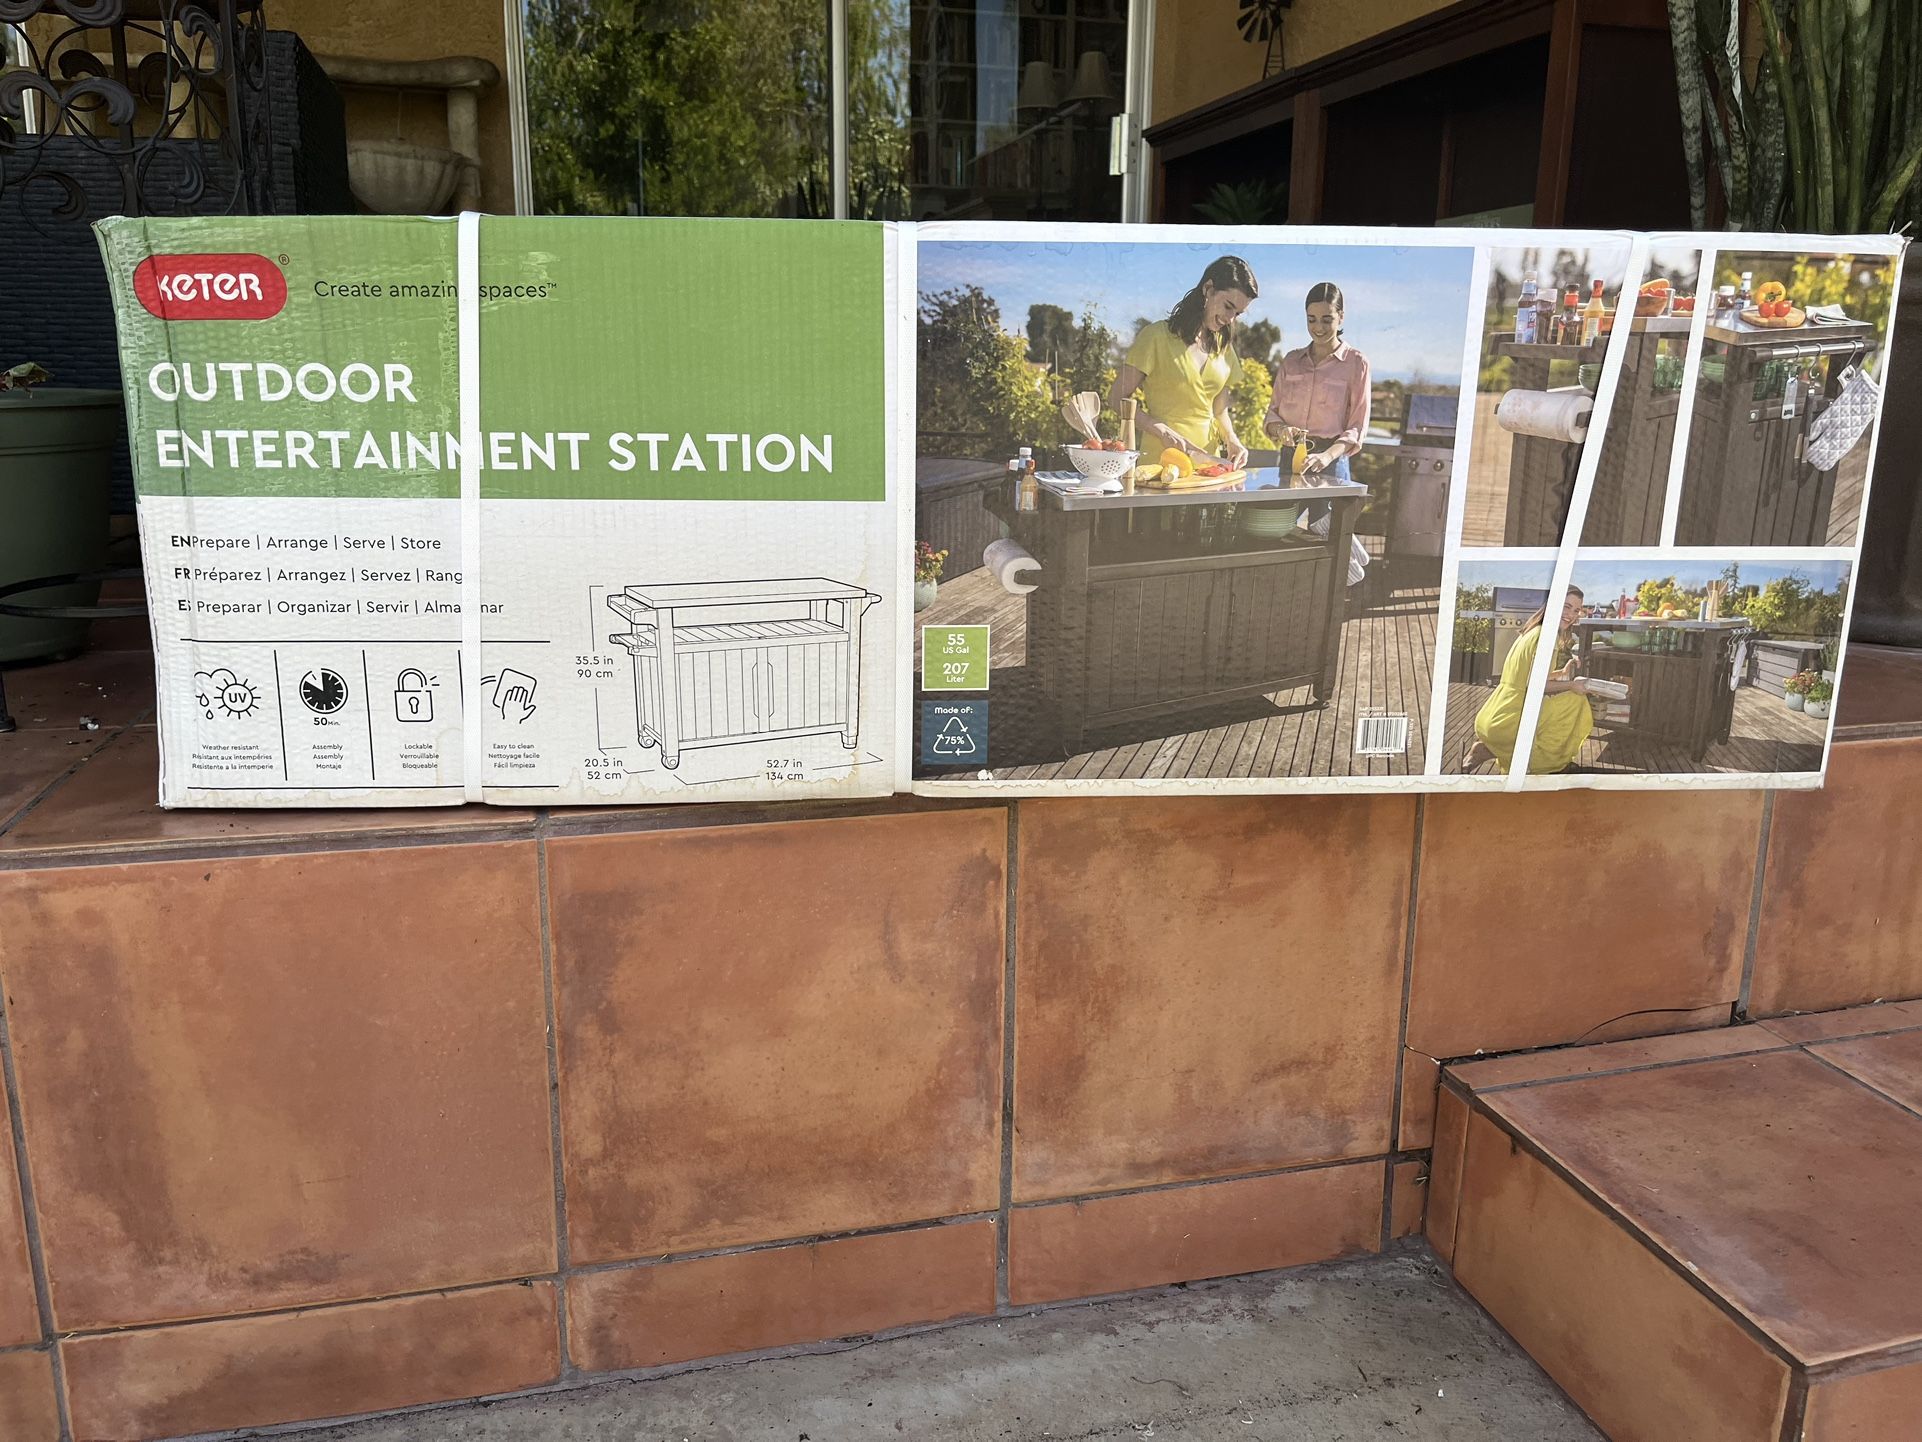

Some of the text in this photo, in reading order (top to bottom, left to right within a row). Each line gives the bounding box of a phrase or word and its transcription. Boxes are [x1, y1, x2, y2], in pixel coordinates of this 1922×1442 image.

[314, 280, 382, 298] Create
[390, 279, 458, 298] amazin
[148, 362, 418, 403] OUTDOOR
[608, 432, 833, 473] STATION
[192, 535, 251, 551] Prepare
[267, 536, 328, 552] Arrange
[343, 536, 386, 549] Serve
[400, 536, 441, 550] Store
[174, 567, 191, 580] FR
[194, 566, 262, 584] Préparez
[277, 568, 346, 584] Arrangez
[360, 569, 411, 582] Servez
[196, 600, 262, 616] Preparar
[277, 599, 352, 616] Organizar
[366, 600, 410, 614] Servir
[947, 633, 965, 646] 55
[942, 646, 970, 654] US Gal
[575, 655, 614, 666] 35.5 in
[577, 668, 613, 679] 90 cm
[942, 662, 970, 675] 207
[946, 675, 965, 683] Liter
[228, 692, 247, 704] UV
[944, 735, 965, 745] 75%
[311, 743, 344, 752] Assembly
[492, 743, 508, 751] Easy
[312, 753, 345, 761] Assembly
[399, 752, 440, 760] Verrouillable
[488, 752, 541, 761] Nettoyage facile
[230, 763, 238, 771] la
[238, 763, 274, 772] intemperie
[315, 763, 342, 771] Montaje
[402, 762, 439, 770] Bloqueable
[509, 761, 536, 770] limpieza
[584, 757, 624, 768] 20.5 in
[766, 758, 803, 769] 52.7 in
[587, 770, 622, 781] 52 cm
[765, 771, 804, 781] 134 cm
